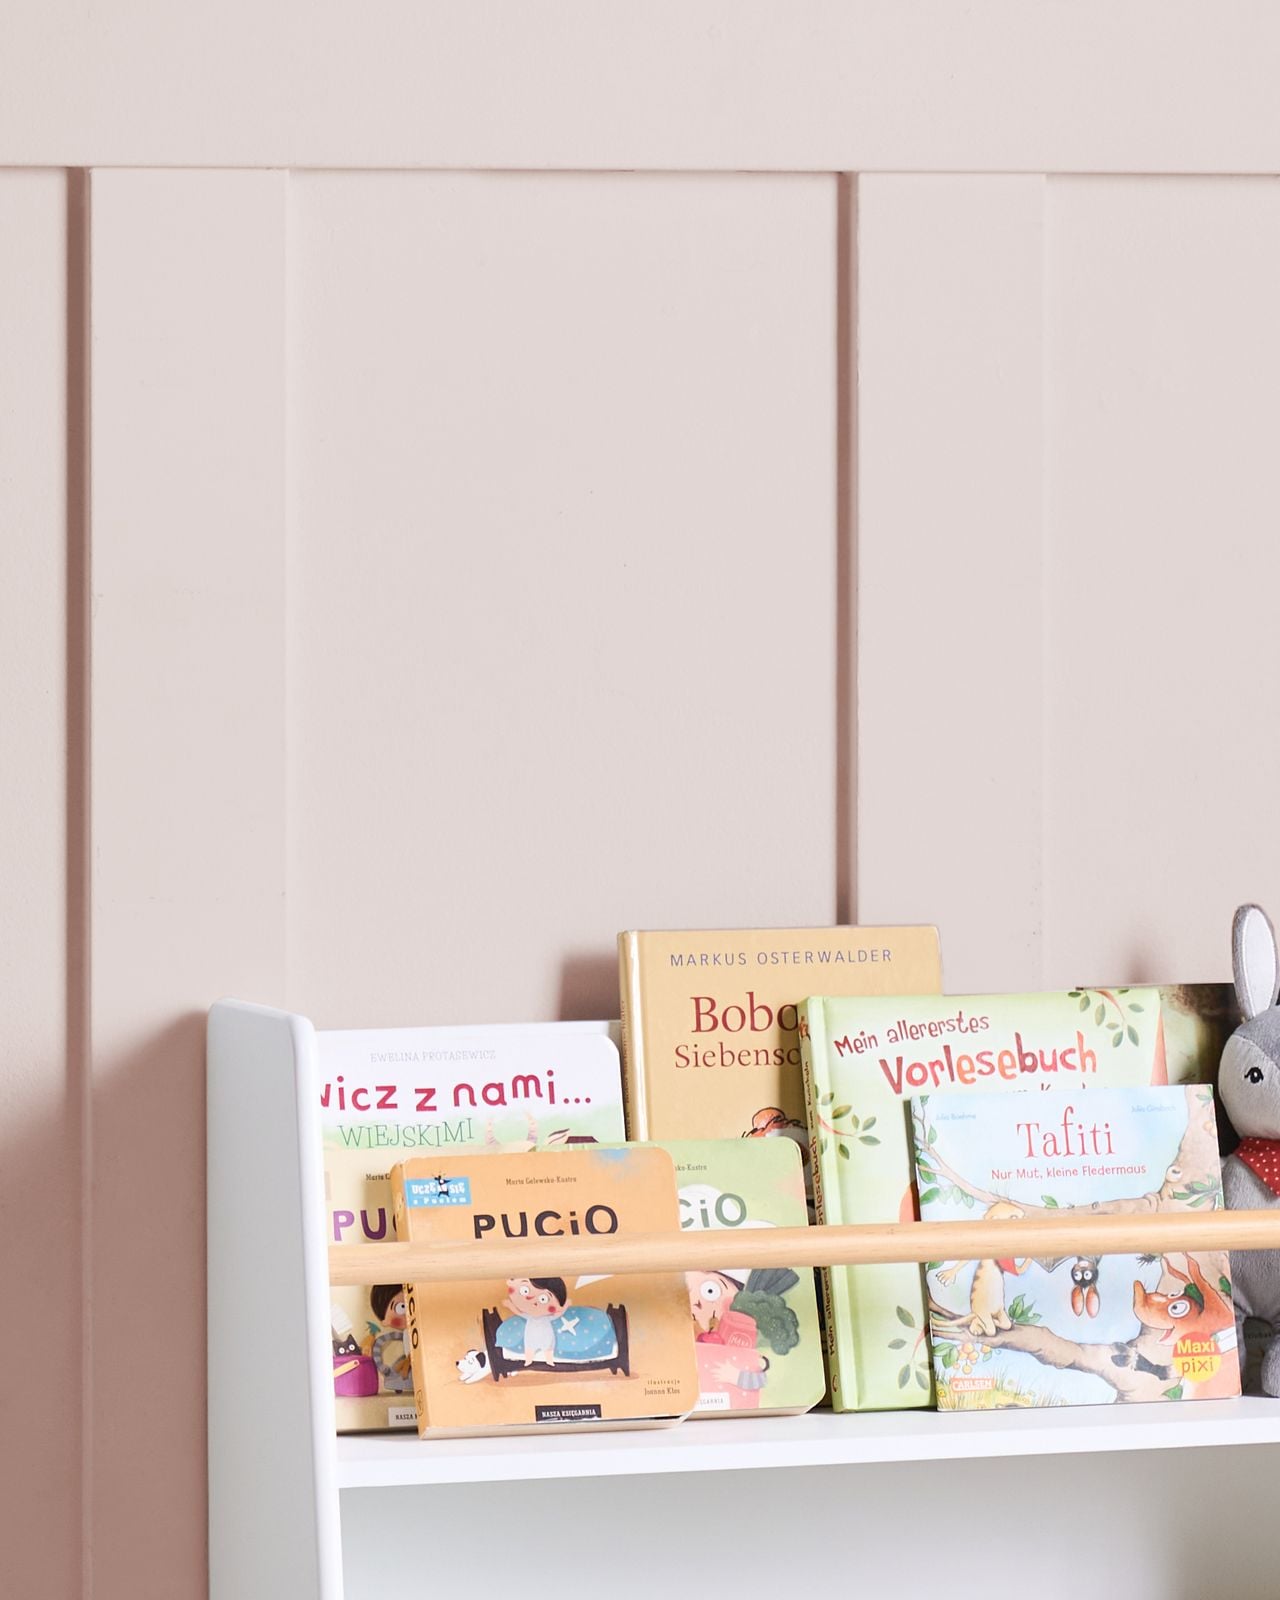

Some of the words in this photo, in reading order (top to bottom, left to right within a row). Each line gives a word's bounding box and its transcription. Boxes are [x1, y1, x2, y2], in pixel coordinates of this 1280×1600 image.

[670, 952, 747, 967] MARKUS
[756, 949, 892, 965] OSTERWALDER
[833, 1031, 879, 1058] Mein
[886, 1010, 990, 1044] allererstes
[370, 1051, 419, 1063] EWELINA
[878, 1029, 1097, 1095] Vorlesebuch
[414, 1087, 438, 1112] z
[453, 1069, 592, 1107] nami...
[337, 1117, 475, 1149] WIEJSKIMI
[1016, 1105, 1117, 1159] Tafiti
[991, 1169, 1013, 1180] Nur
[1016, 1168, 1044, 1180] Mut,
[1046, 1166, 1079, 1177] kleine
[1081, 1165, 1147, 1177] Fledermaus
[1177, 1338, 1215, 1354] Maxi
[1181, 1356, 1214, 1376] pixi
